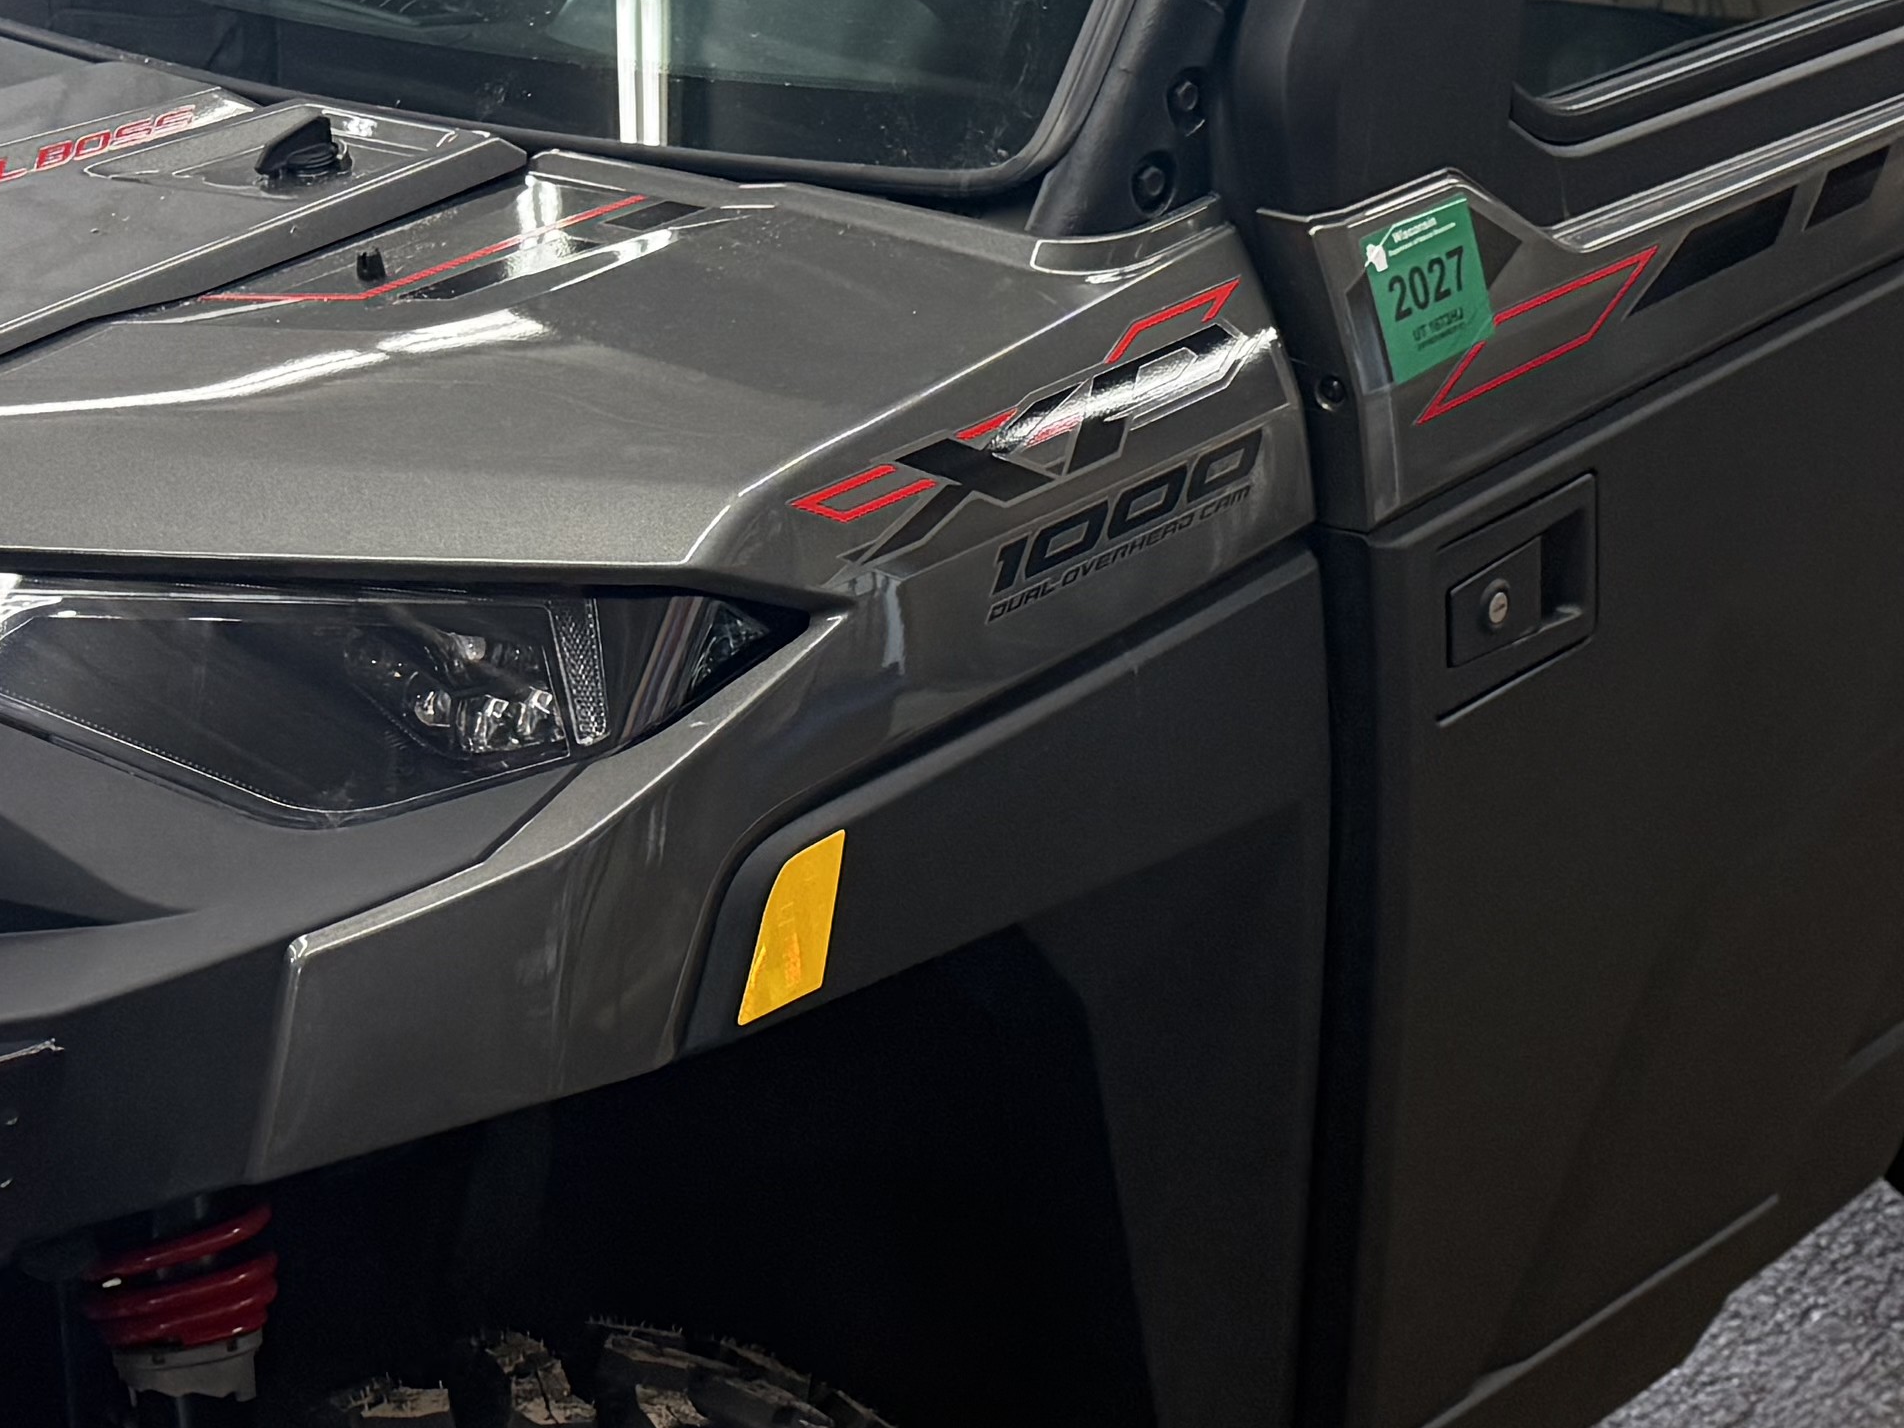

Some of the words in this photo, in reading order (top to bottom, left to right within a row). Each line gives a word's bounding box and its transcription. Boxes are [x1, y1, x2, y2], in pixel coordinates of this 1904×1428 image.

[33, 105, 196, 172] BOSS
[1388, 245, 1464, 322] 2027
[992, 428, 1264, 597] 1000
[1200, 484, 1252, 522] CAM
